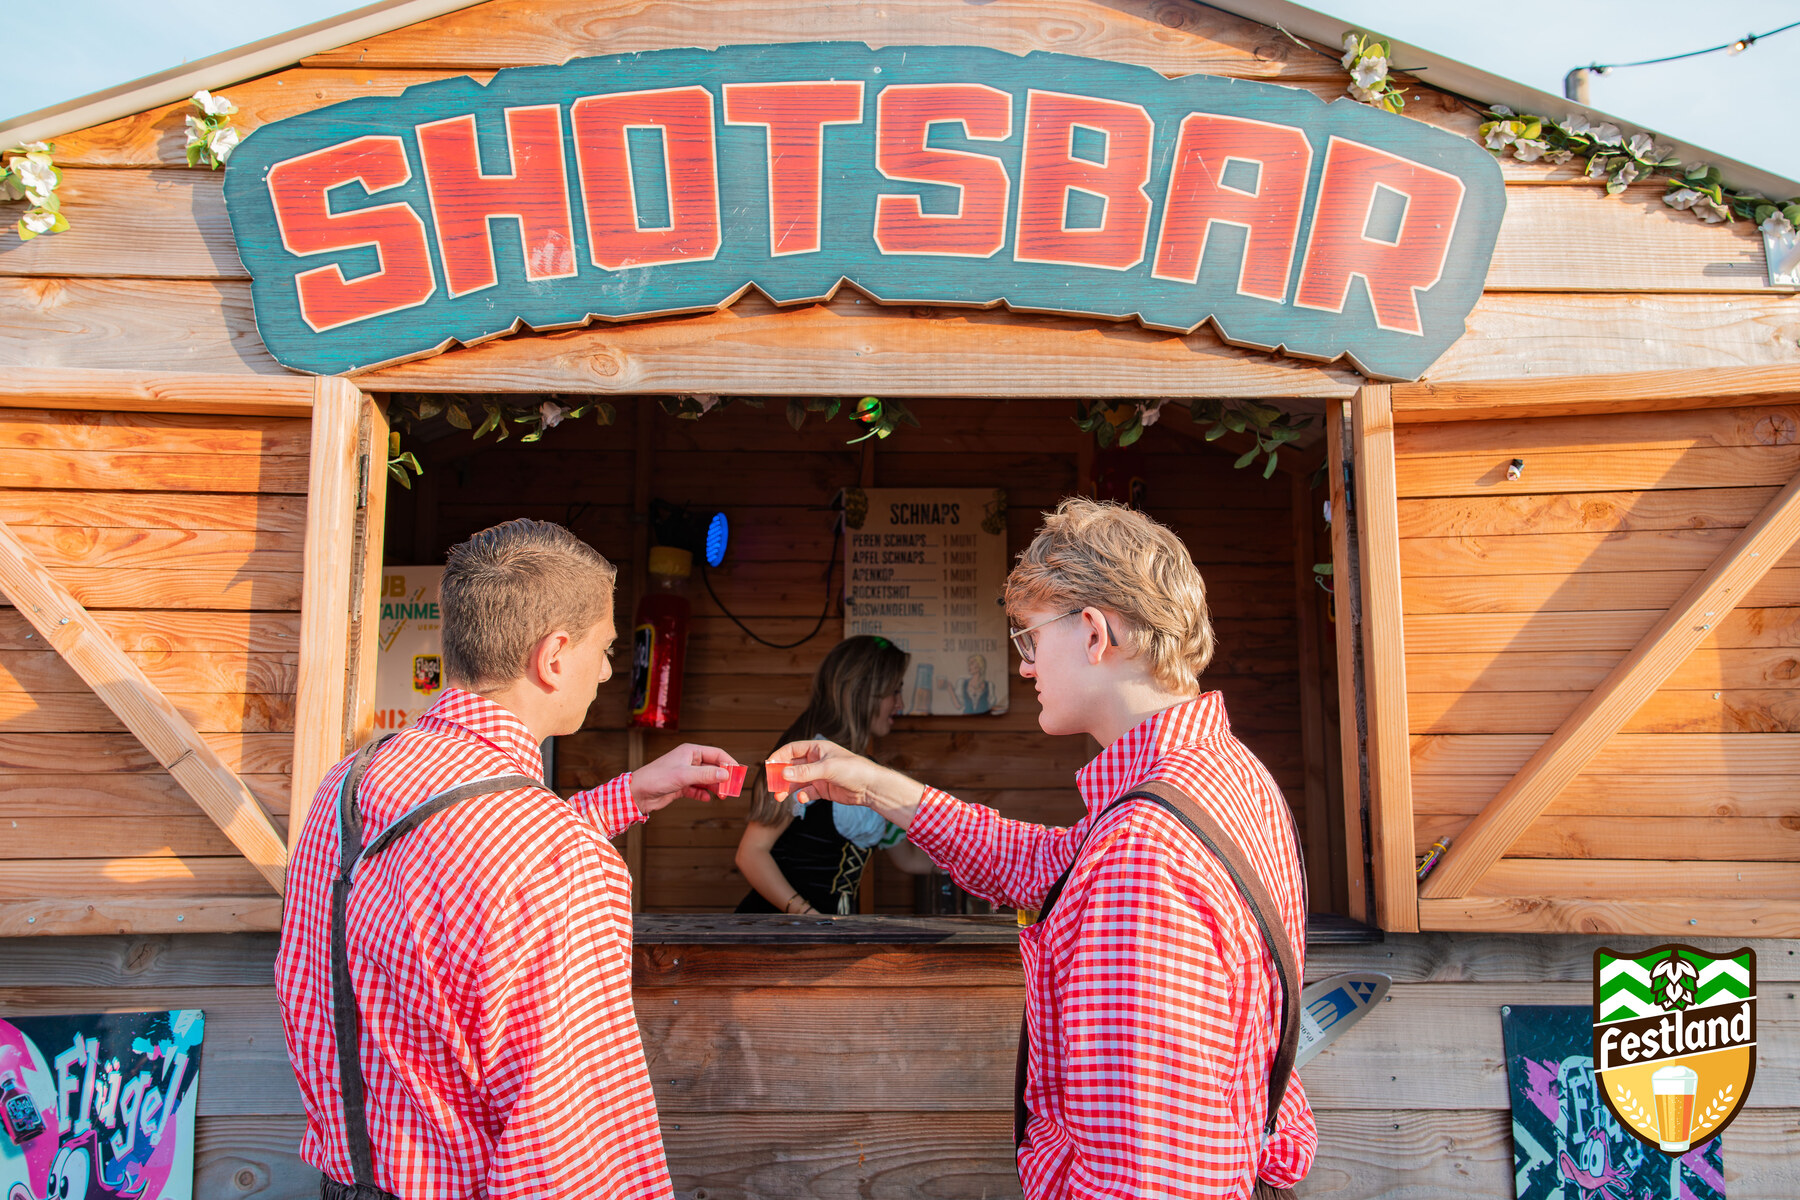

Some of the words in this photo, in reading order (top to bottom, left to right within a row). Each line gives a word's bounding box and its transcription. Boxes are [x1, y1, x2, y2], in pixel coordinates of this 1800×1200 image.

[266, 80, 1467, 337] SHOTSBAR
[889, 503, 960, 525] SCHNAPS
[943, 534, 948, 547] 1
[950, 534, 977, 547] MUNT
[852, 551, 879, 564] APFEL
[943, 551, 948, 564] 1
[950, 551, 977, 564] MUNT
[852, 568, 894, 581] APENKOP
[943, 568, 948, 581] 1
[950, 568, 977, 581] MUNT
[852, 585, 911, 599] ROCKETSHOT
[943, 586, 948, 599] 1
[950, 586, 977, 599] MUNT
[852, 603, 925, 616] BOSWANDELING
[943, 603, 948, 616] 1
[950, 603, 977, 616] MUNT
[943, 621, 948, 634] 1
[950, 621, 977, 634] MUNT
[958, 639, 998, 652] MUNTEN
[54, 1031, 190, 1162] Flügel
